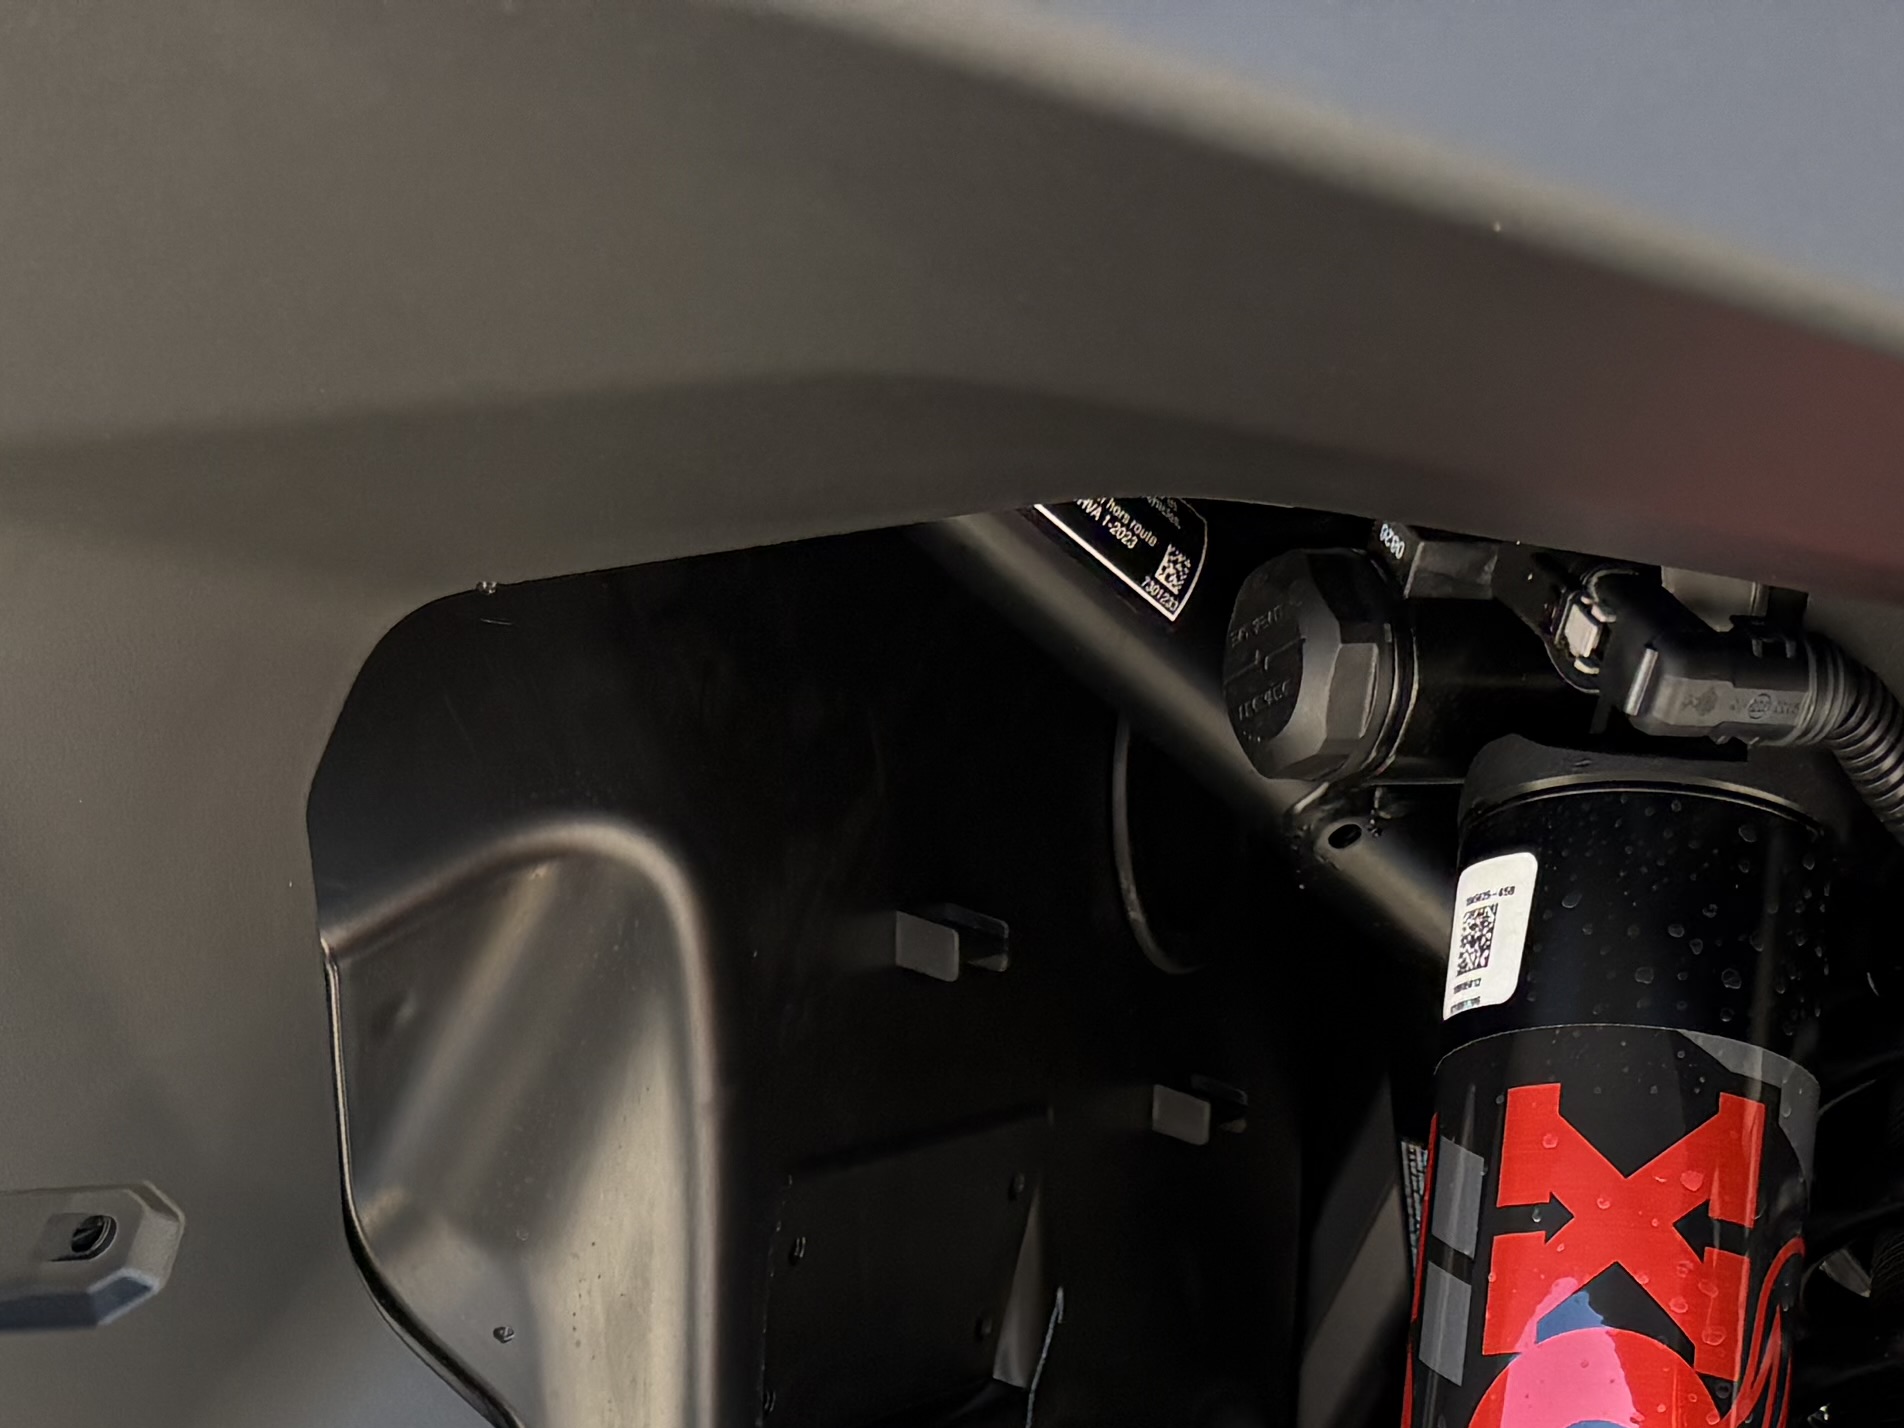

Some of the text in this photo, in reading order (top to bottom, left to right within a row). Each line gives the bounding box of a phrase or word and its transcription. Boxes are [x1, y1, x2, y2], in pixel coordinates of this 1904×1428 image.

[1074, 497, 1139, 549] HVA 1-2023
[1129, 518, 1159, 548] route
